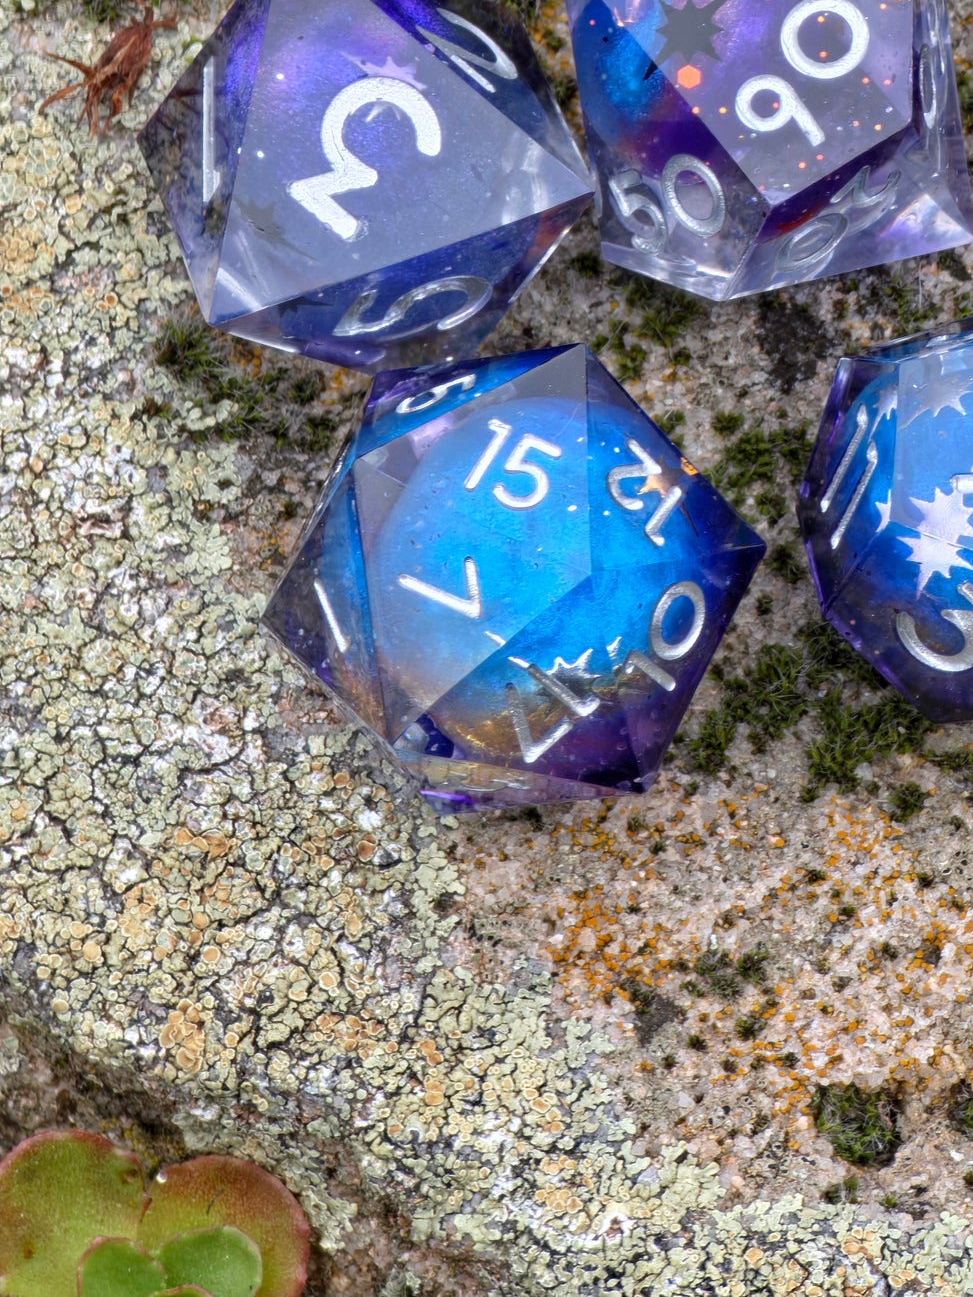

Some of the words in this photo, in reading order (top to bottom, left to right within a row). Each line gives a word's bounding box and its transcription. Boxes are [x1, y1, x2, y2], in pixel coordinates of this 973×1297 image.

[287, 76, 441, 241] 3
[608, 154, 725, 255] 50
[464, 419, 561, 510] 15
[399, 557, 480, 619] 7
[625, 582, 705, 692] 10
